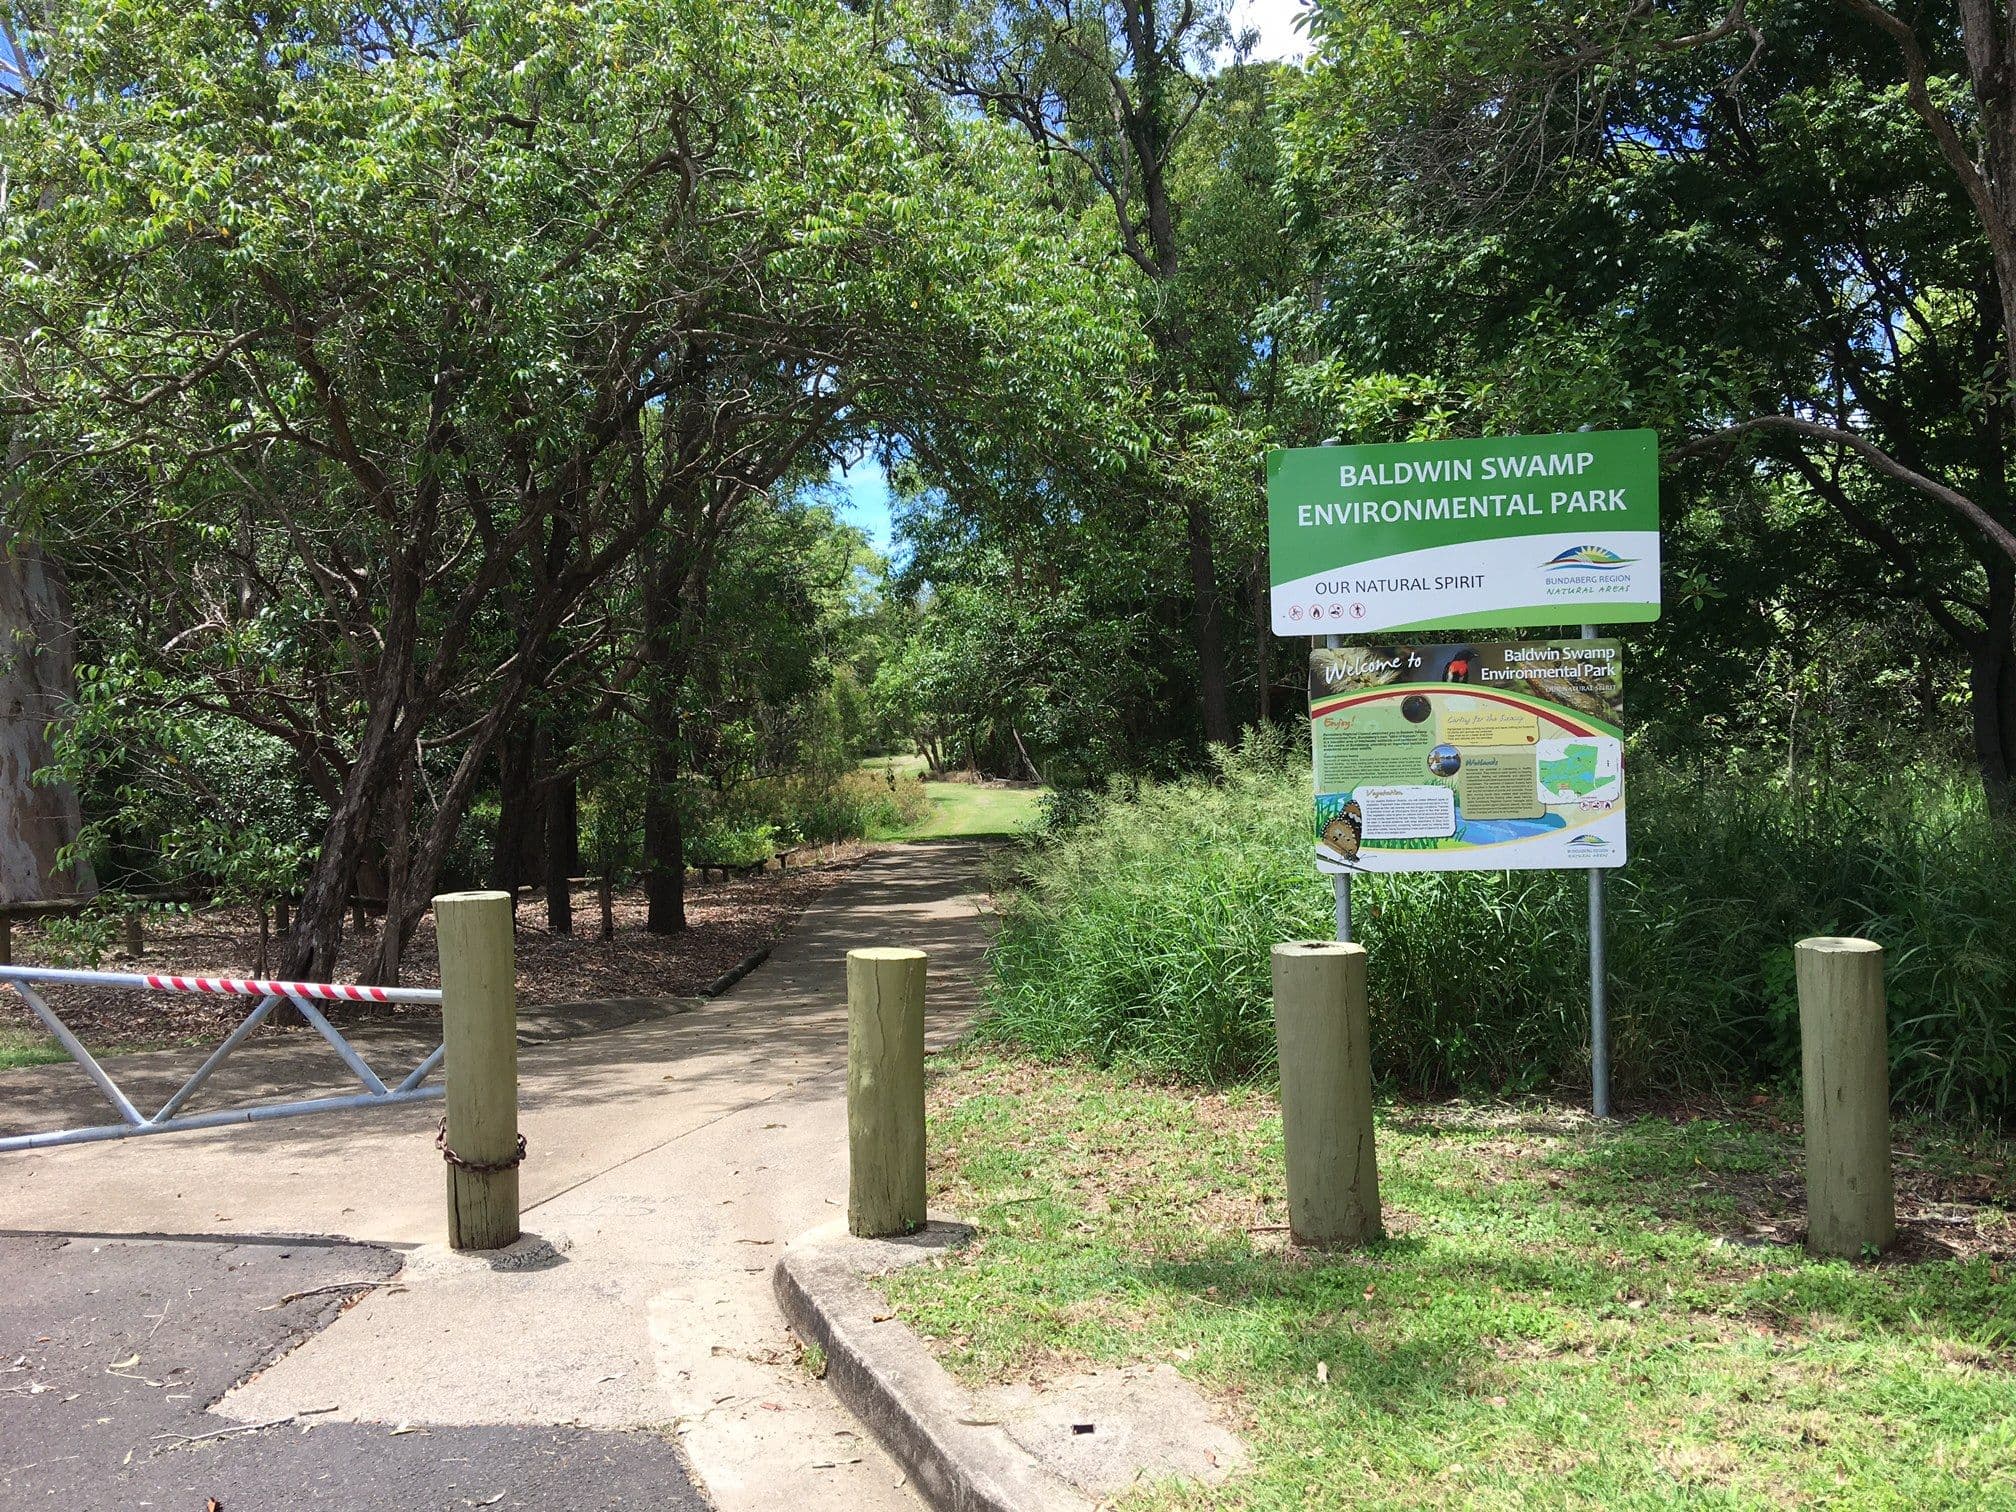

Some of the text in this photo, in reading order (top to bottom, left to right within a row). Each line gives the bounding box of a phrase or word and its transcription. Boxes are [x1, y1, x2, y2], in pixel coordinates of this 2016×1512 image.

[1339, 452, 1594, 488] BALDWIN SWAMP
[1298, 488, 1627, 526] ENVIRONMENTAL PARK
[1315, 575, 1485, 594] OUR NATURAL SPIRIT
[1545, 574, 1631, 585] BUNDABERG REGION
[1546, 585, 1630, 595] NATURAL AREAS
[1504, 647, 1615, 663] Baldwin Swamp
[1325, 652, 1421, 684] Welcome to
[1481, 663, 1616, 681] Environmental Park
